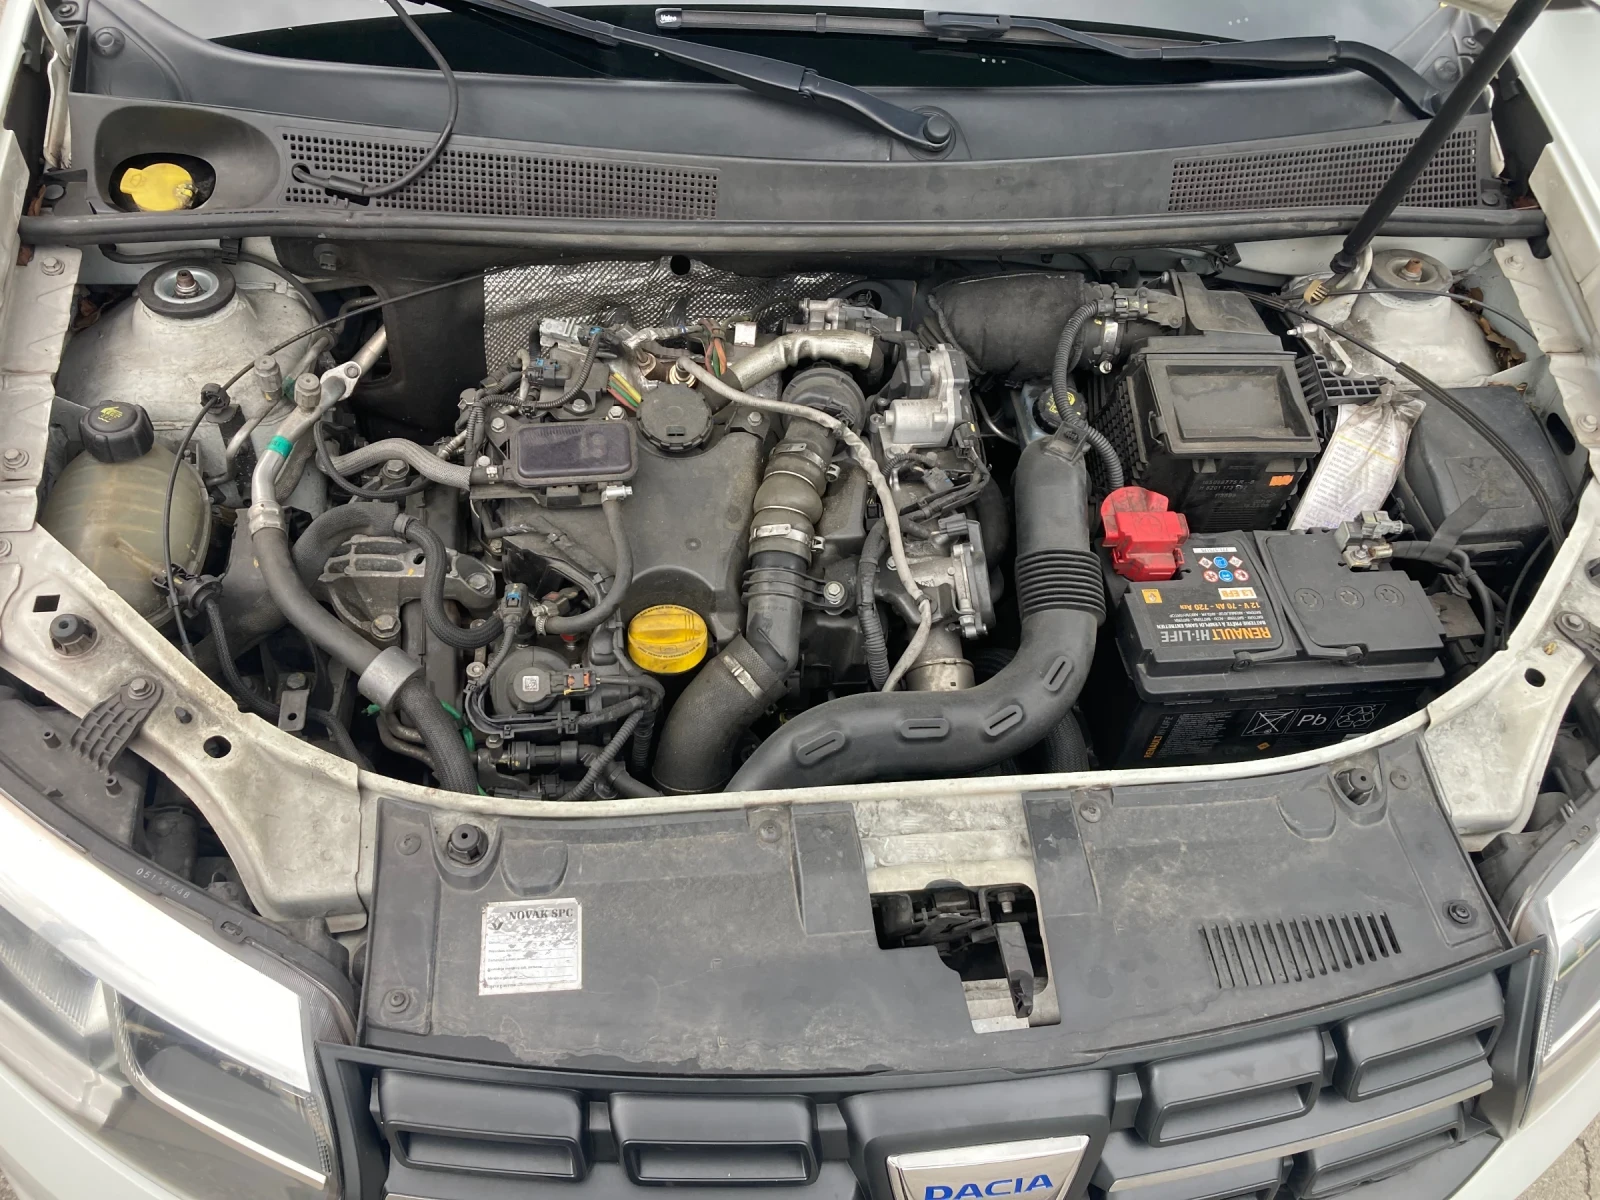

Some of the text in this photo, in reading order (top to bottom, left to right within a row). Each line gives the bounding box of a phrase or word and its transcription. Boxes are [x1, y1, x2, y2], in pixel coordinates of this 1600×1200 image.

[1220, 589, 1240, 598] EFB
[1193, 603, 1210, 611] 720
[1215, 602, 1225, 610] Ah
[1250, 601, 1261, 609] 12
[1212, 627, 1272, 640] RENAULT
[1297, 713, 1328, 727] Pb
[509, 908, 574, 919] NOVAK SPC
[924, 1174, 1053, 1200] DACIA
